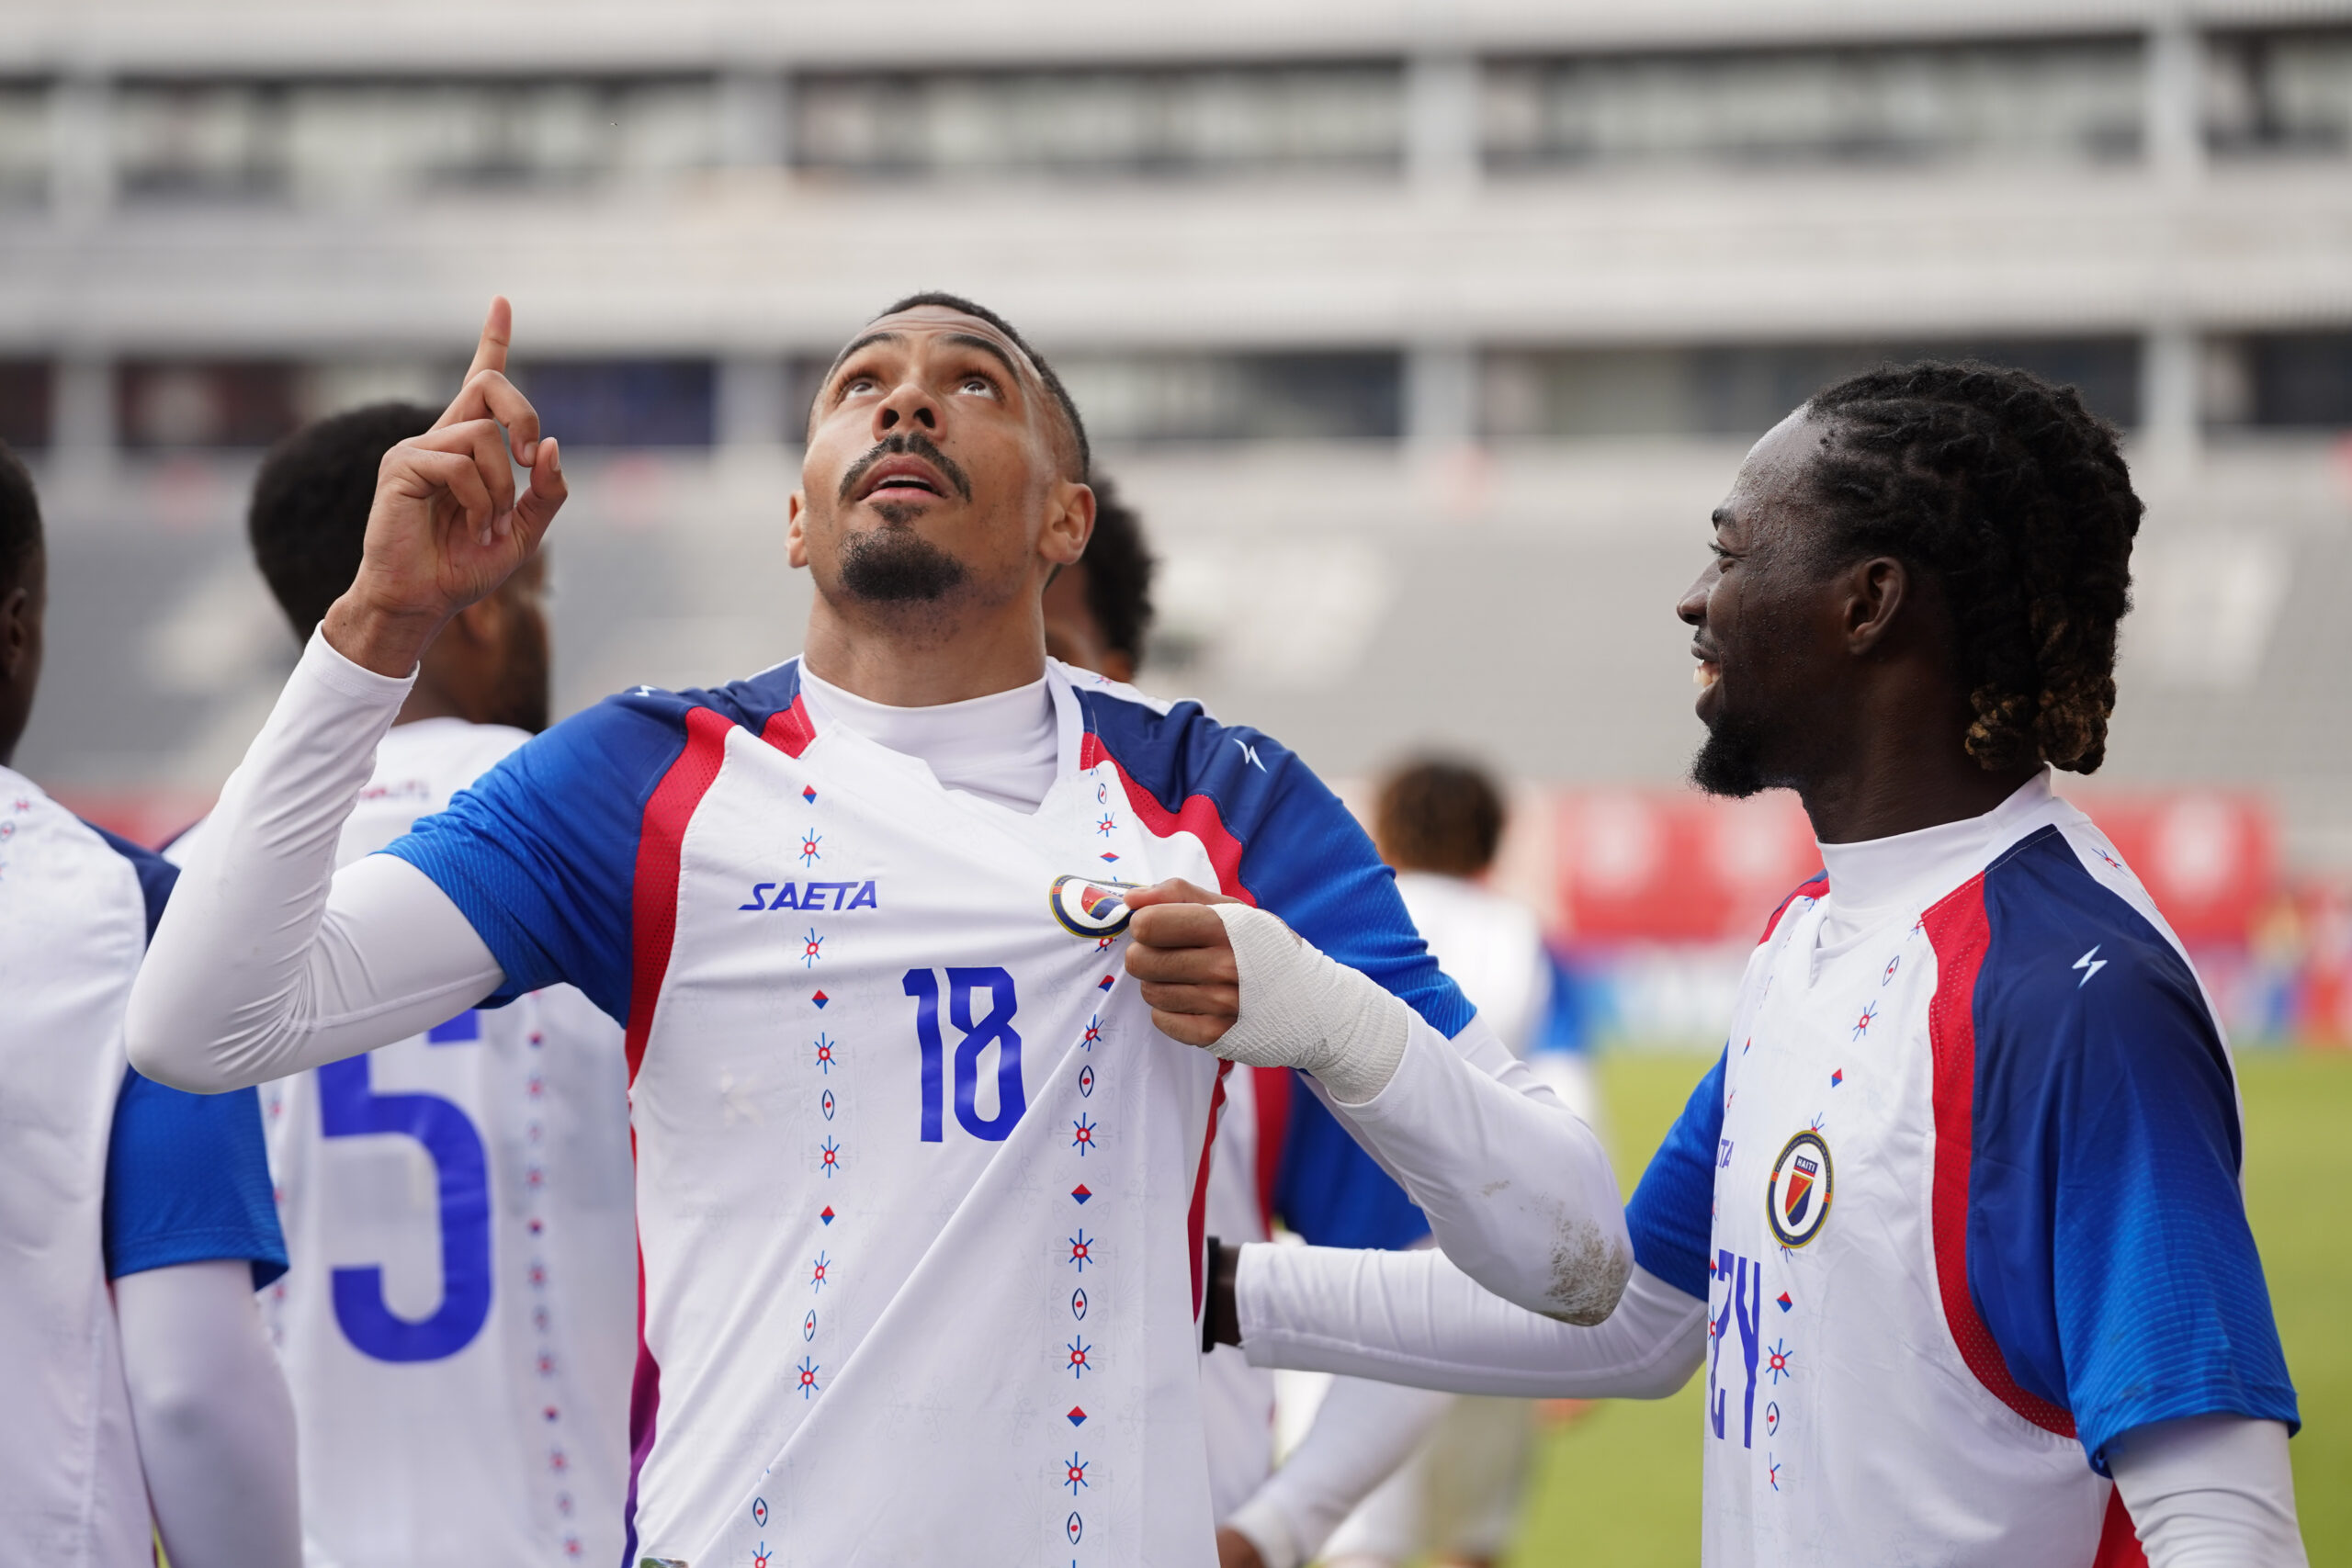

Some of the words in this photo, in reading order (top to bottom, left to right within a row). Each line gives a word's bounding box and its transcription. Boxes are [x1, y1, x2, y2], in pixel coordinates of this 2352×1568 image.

[738, 880, 877, 911] SAETA
[902, 966, 1028, 1143] 18
[316, 1007, 492, 1364] 5
[1796, 1157, 1815, 1173] HAITI
